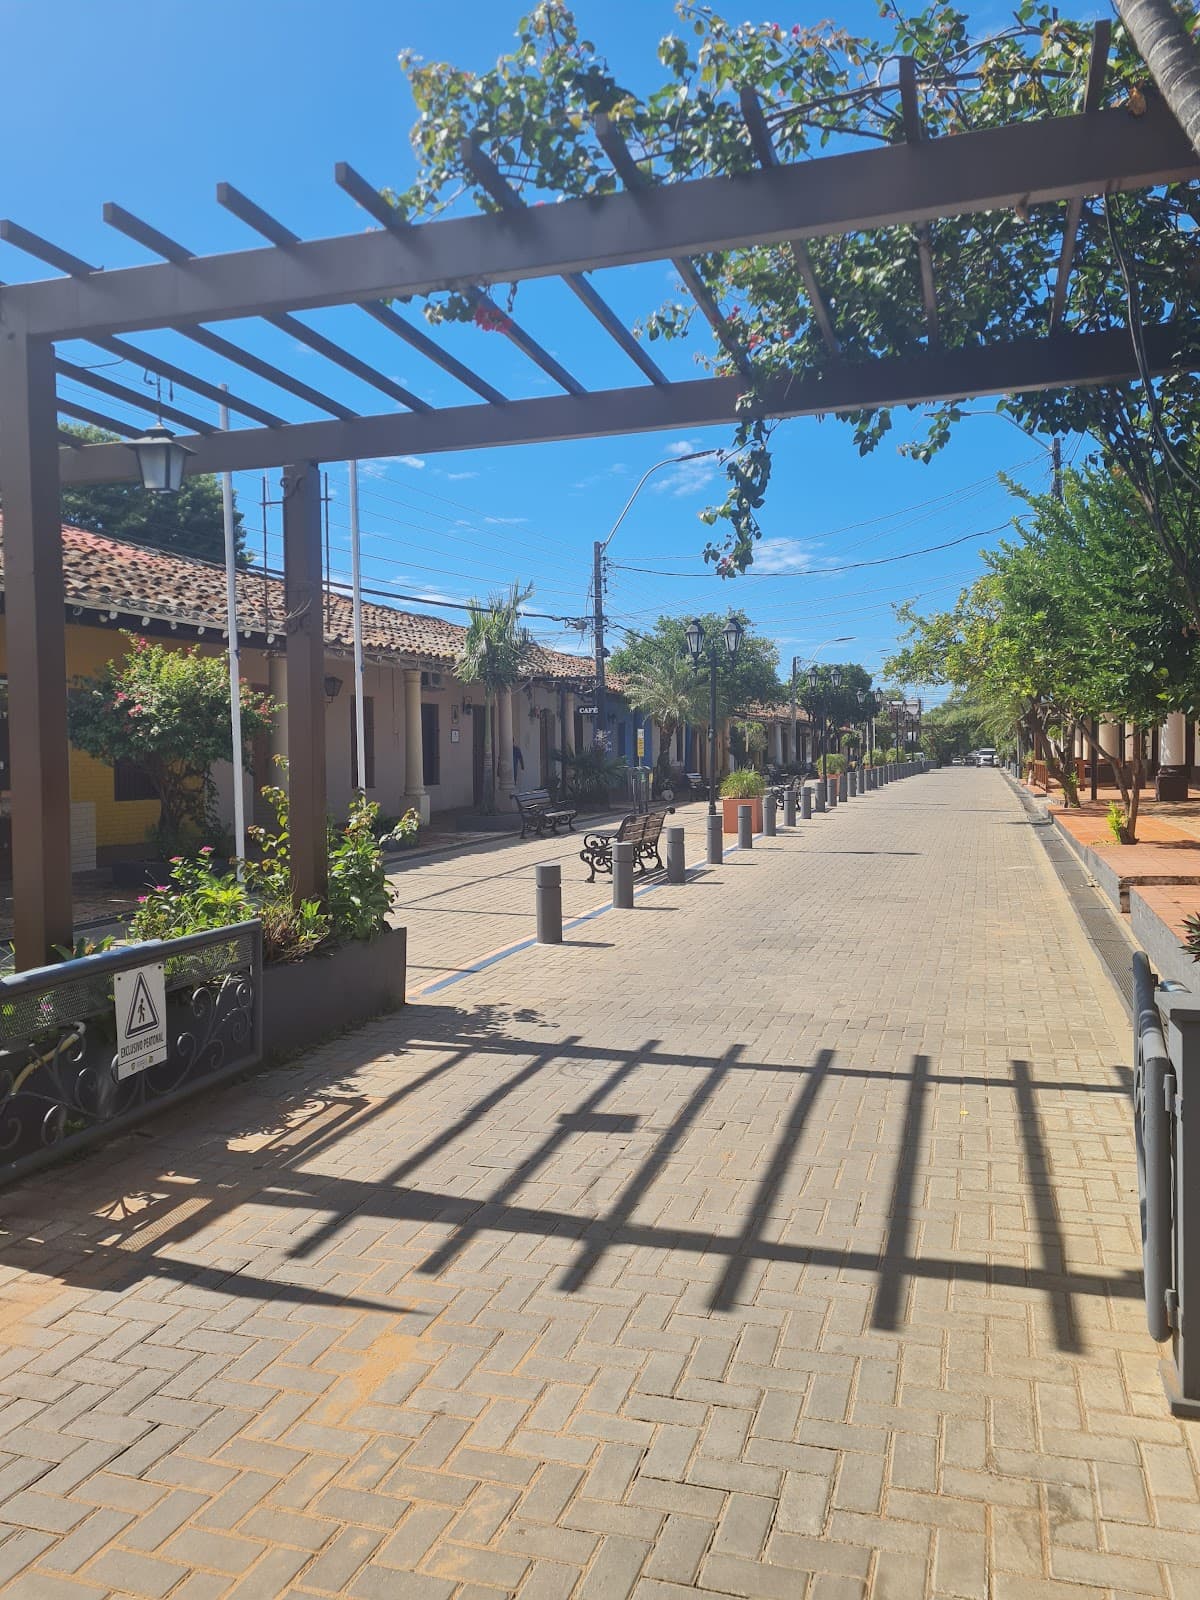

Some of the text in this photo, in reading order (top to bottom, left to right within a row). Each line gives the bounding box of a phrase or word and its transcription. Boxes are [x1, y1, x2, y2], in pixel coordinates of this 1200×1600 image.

[579, 706, 599, 714] CAFÉ
[120, 1032, 164, 1058] EXCLUSIVO PEATONAL
